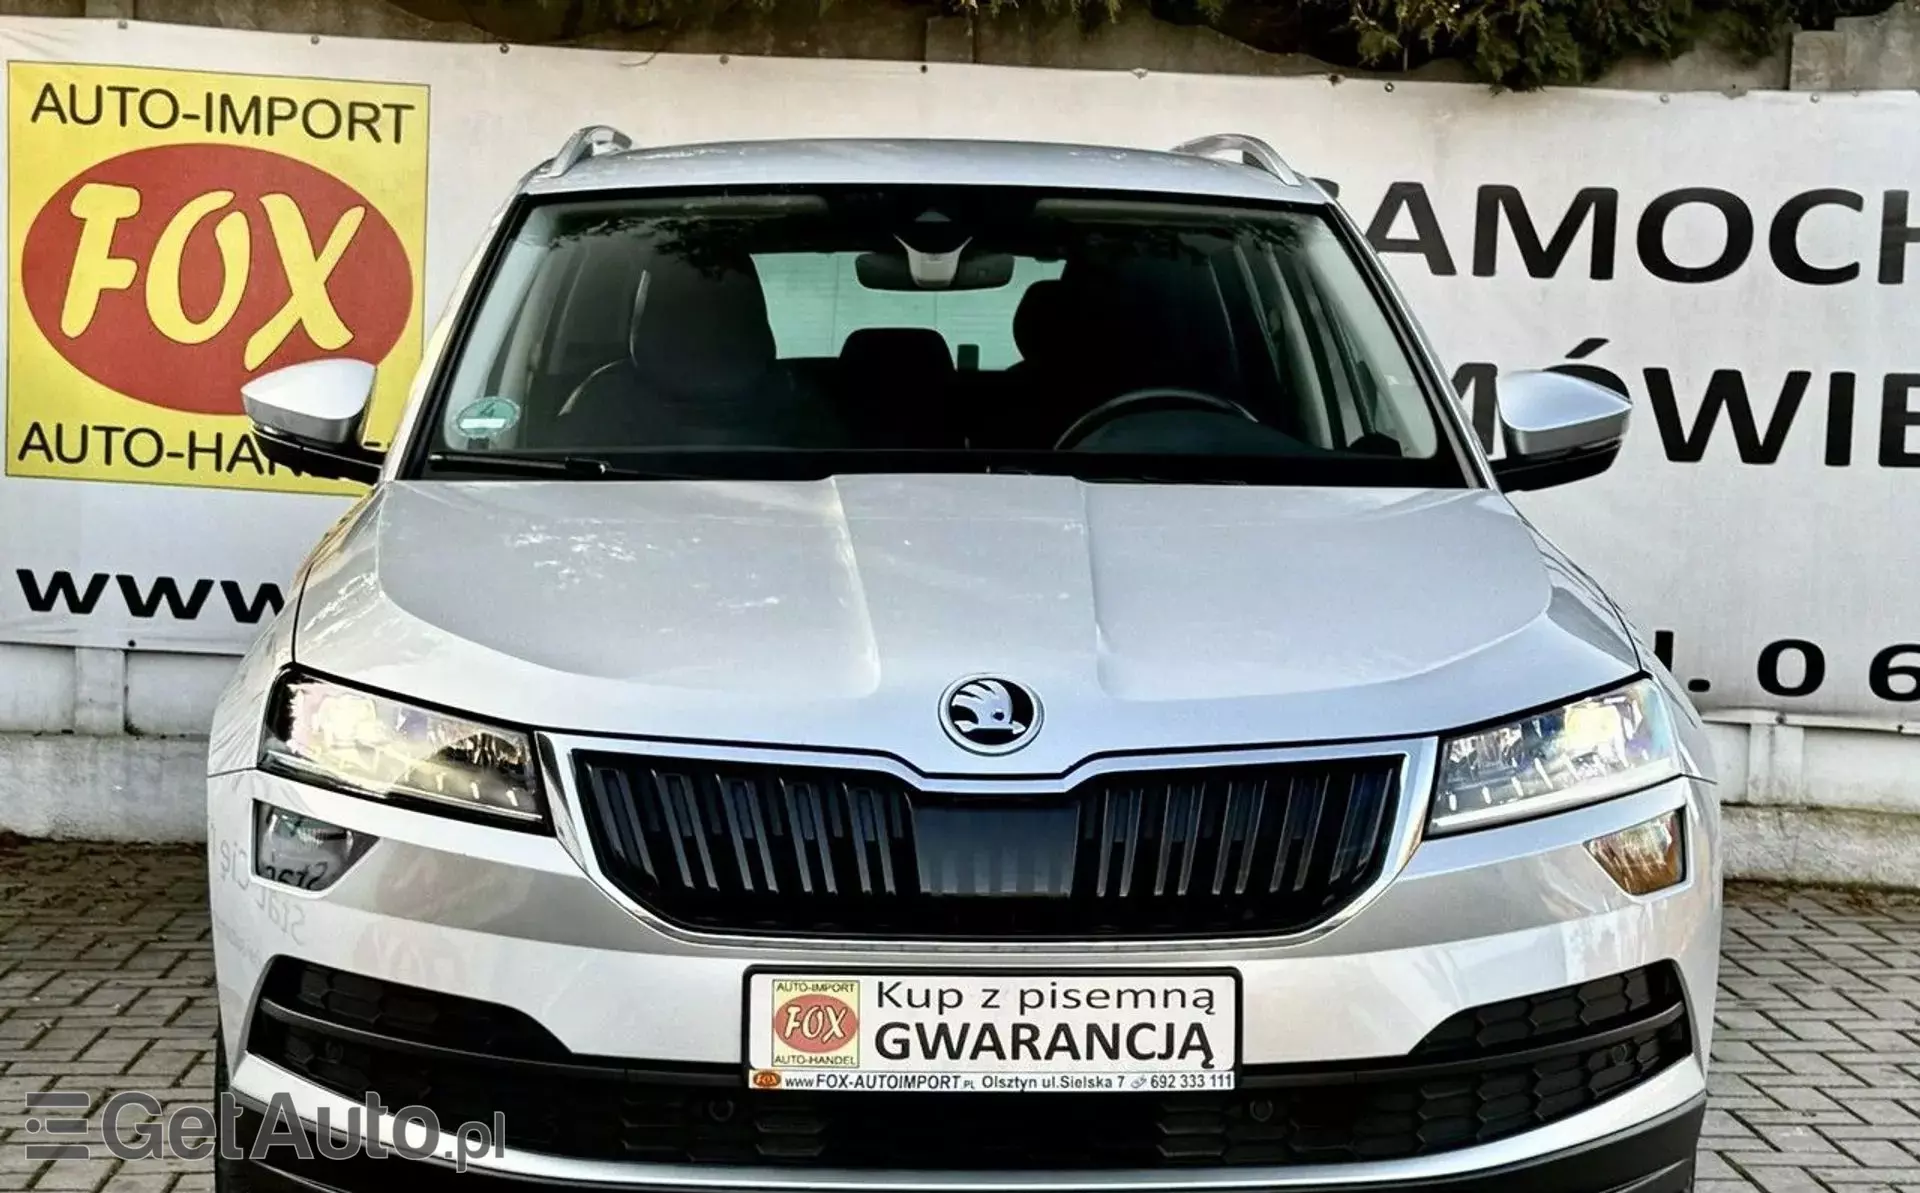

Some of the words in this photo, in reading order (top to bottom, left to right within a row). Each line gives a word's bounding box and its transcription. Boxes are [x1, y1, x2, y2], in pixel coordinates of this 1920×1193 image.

[31, 82, 415, 143] AUTO-IMPORT
[1323, 177, 1920, 286] AMOC
[60, 182, 366, 372] FOX
[18, 421, 391, 477] AUTO-HA
[776, 982, 855, 993] AUTO-IMPORT
[877, 981, 964, 1015] Kup
[981, 988, 1001, 1008] z
[1019, 981, 1215, 1016] pisemną
[783, 1004, 849, 1045] FOX
[874, 1021, 1214, 1069] GWARANCJĄ
[774, 1054, 856, 1066] AUTO-HANDEL
[981, 1075, 1037, 1092] Olsztyn
[1116, 1074, 1125, 1088] 7
[1150, 1074, 1177, 1089] 692
[1180, 1074, 1205, 1089] 333
[1209, 1073, 1232, 1088] 111
